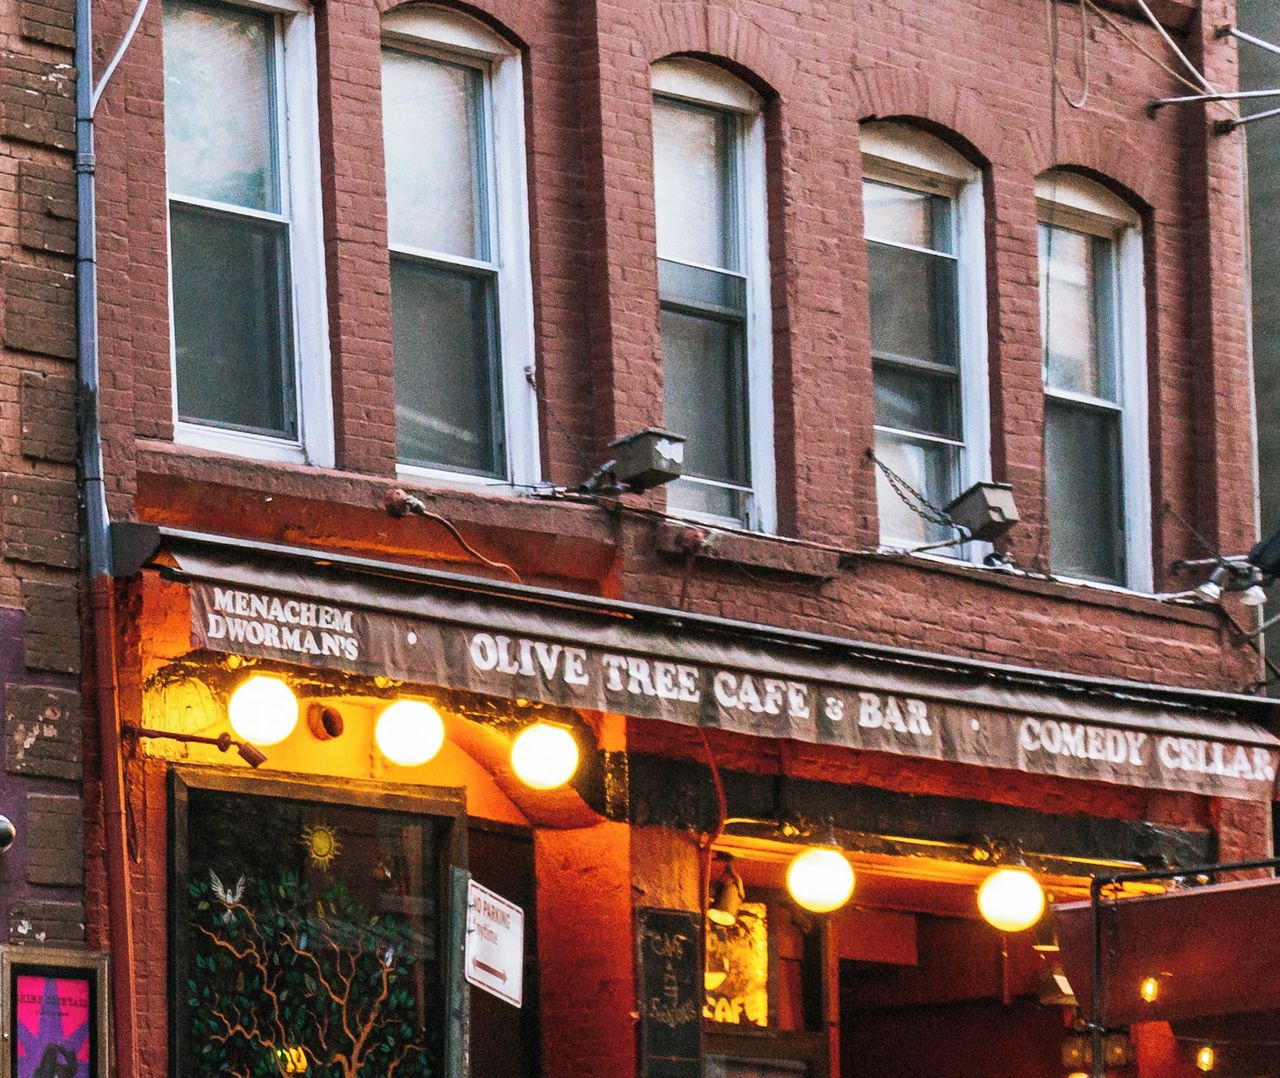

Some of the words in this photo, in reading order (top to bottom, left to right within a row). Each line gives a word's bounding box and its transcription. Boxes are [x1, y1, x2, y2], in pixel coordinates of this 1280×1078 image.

[212, 586, 354, 635] MENACHEM
[207, 613, 360, 662] DWORMAN'S
[470, 632, 591, 687] OLIVE
[602, 654, 702, 704] TREE
[714, 669, 810, 720] CAFE
[859, 690, 934, 737] BAR
[1018, 716, 1146, 768] COMEDY
[1158, 735, 1276, 782] CELLAR
[483, 899, 511, 930] PARKING
